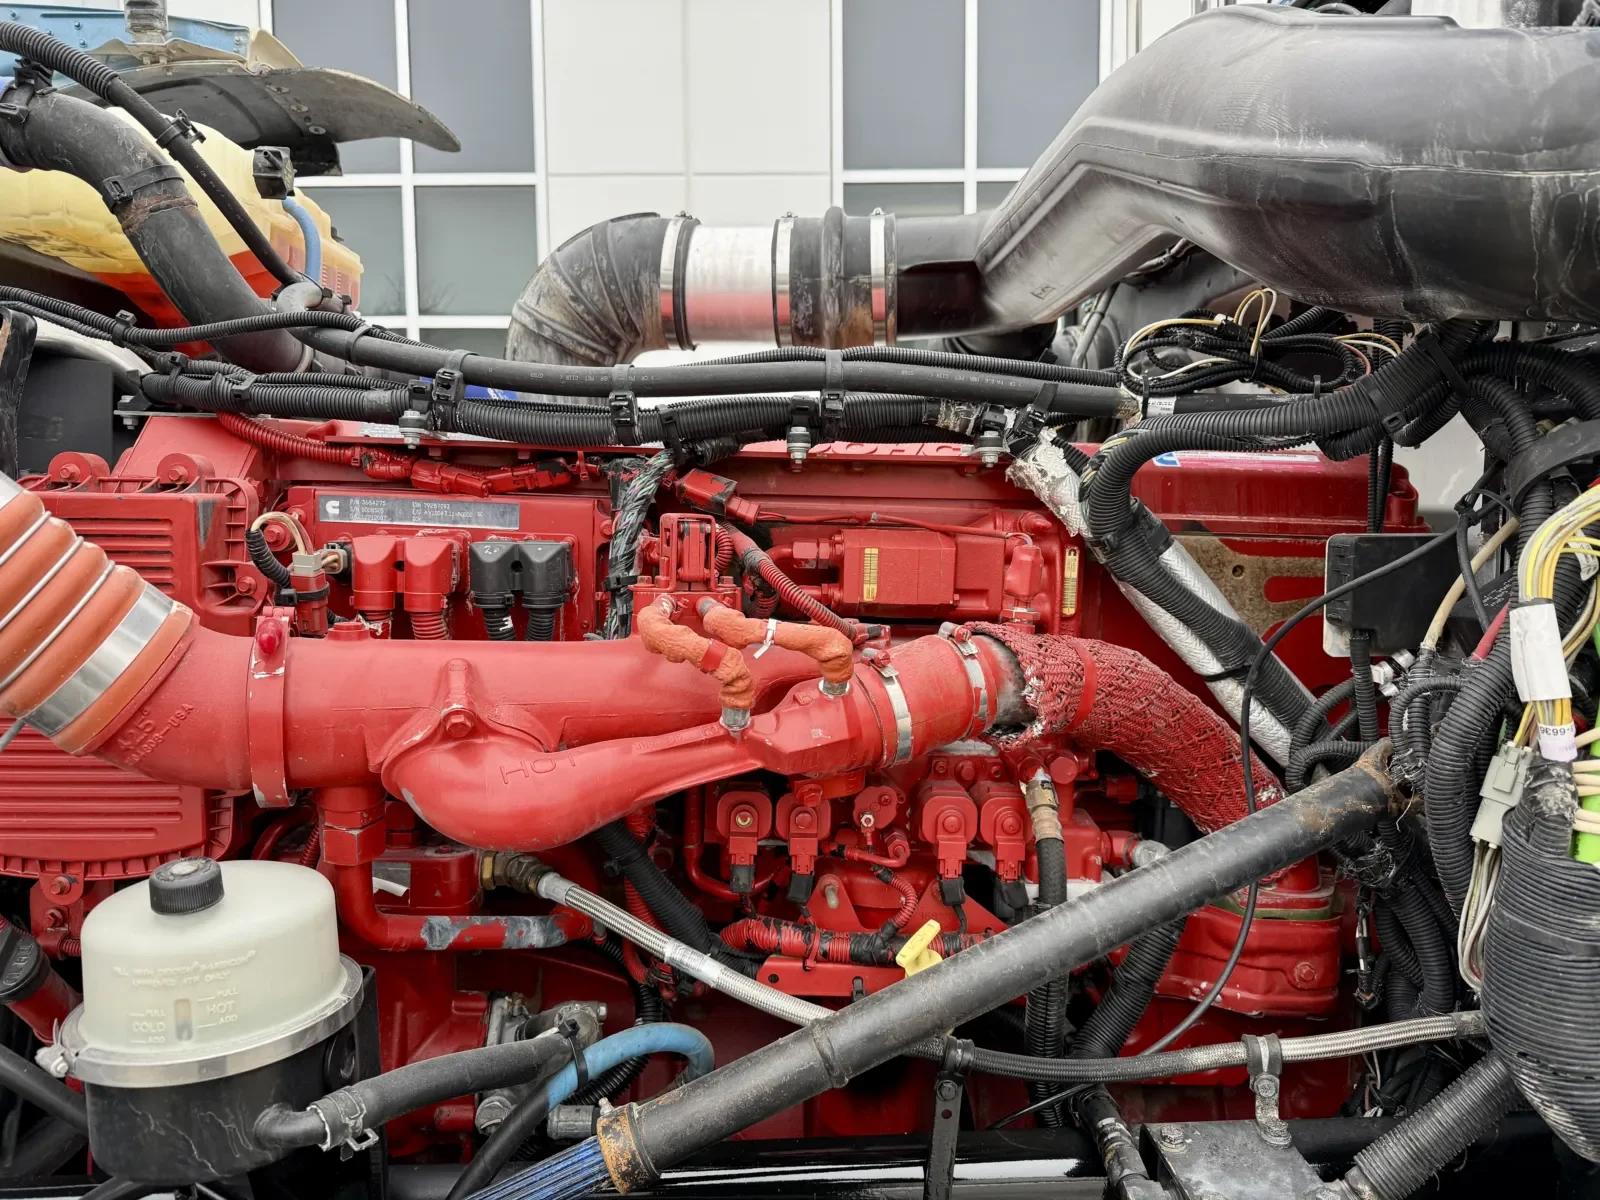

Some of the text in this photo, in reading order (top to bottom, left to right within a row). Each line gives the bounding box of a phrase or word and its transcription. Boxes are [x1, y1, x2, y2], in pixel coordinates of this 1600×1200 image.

[206, 1000, 236, 1016] HOT
[218, 1014, 239, 1025] ADD
[131, 1021, 167, 1034] COLD
